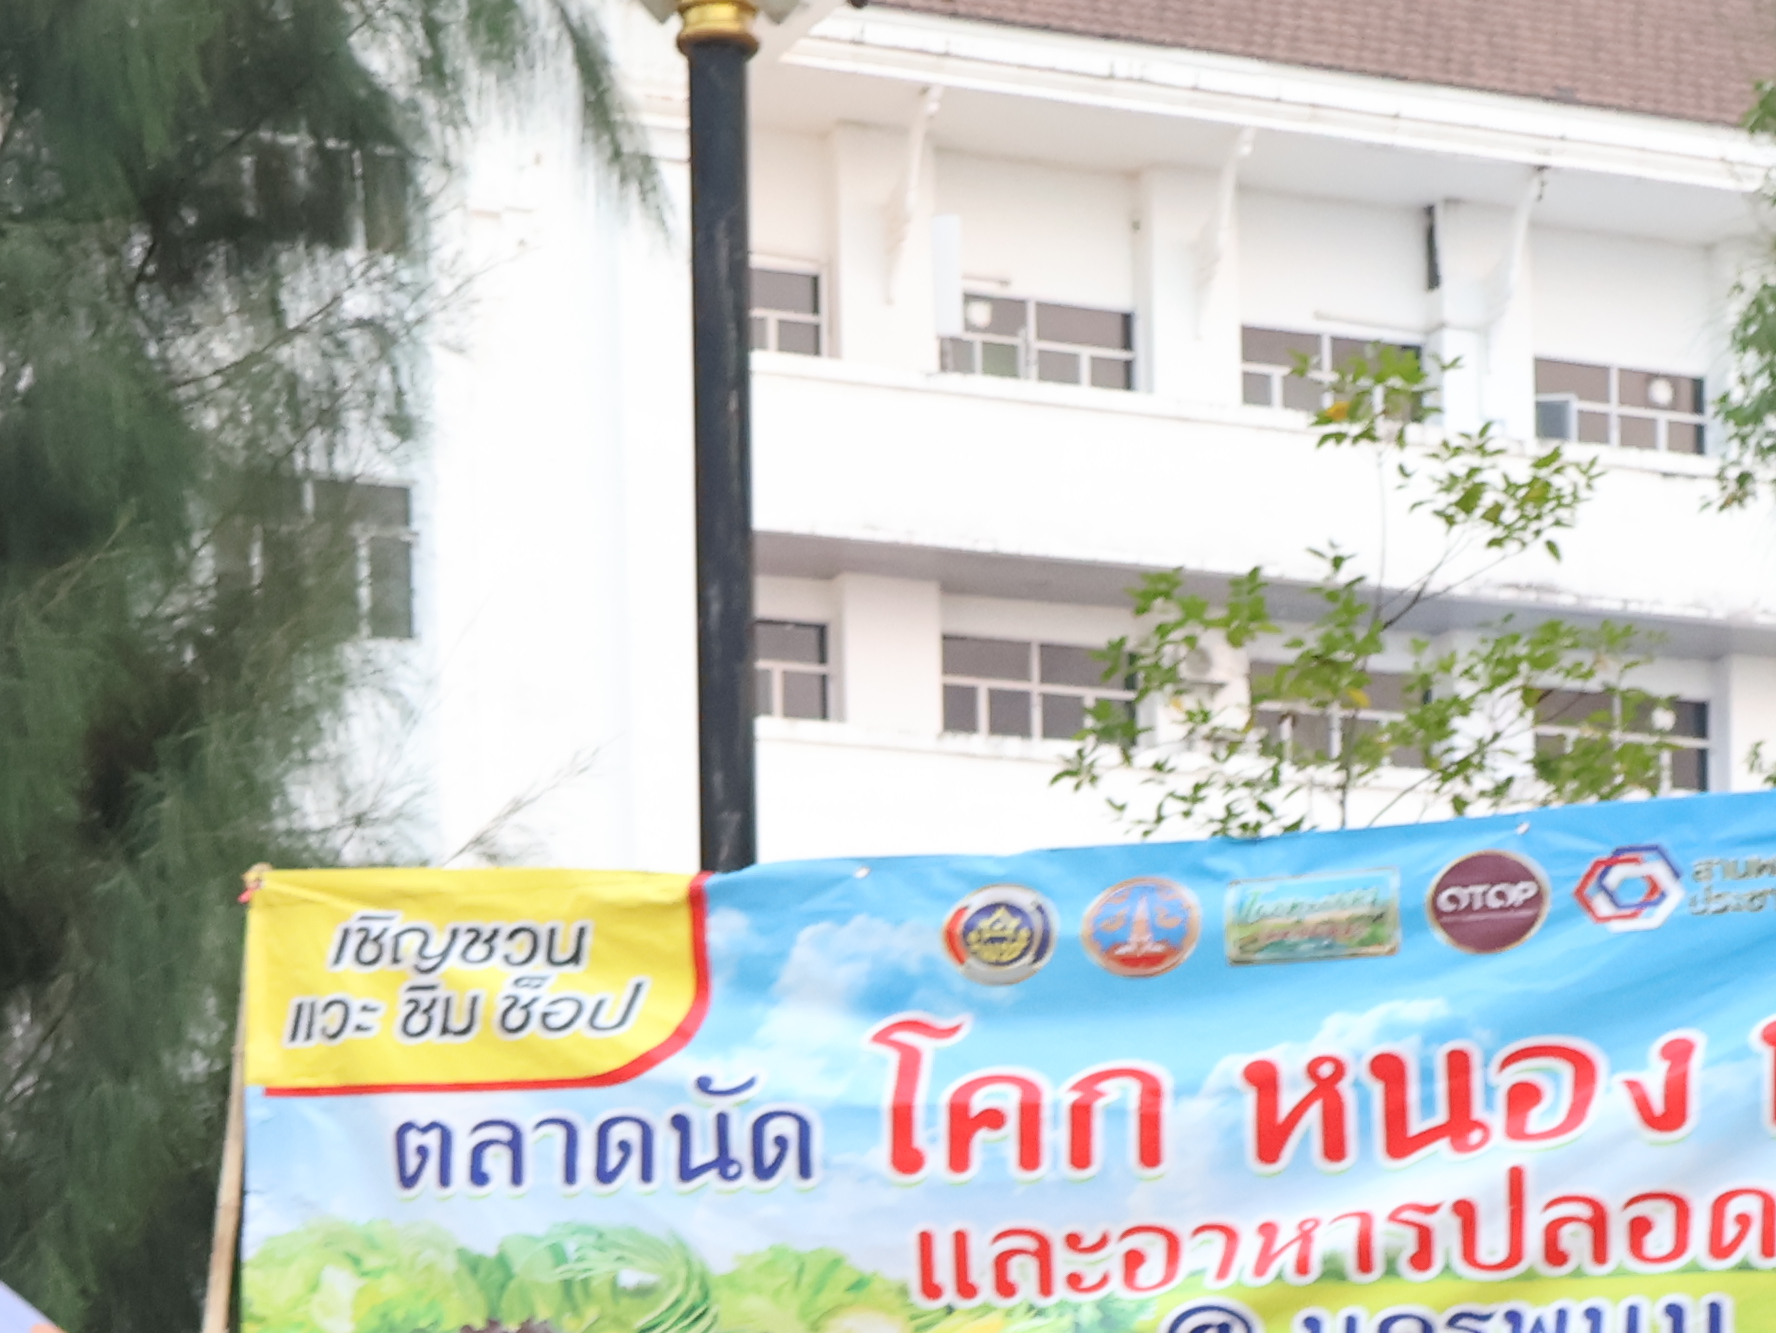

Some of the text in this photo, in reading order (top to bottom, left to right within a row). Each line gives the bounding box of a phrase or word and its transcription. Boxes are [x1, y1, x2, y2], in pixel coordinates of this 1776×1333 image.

[1435, 880, 1540, 913] OTOP
[330, 915, 587, 974] เชิญชวน
[289, 976, 643, 1042] แวะ ชิม ช็อป
[396, 1073, 812, 1187] ตลาดนัด
[872, 1017, 1164, 1176] โคก
[1243, 1036, 1697, 1165] หนอง
